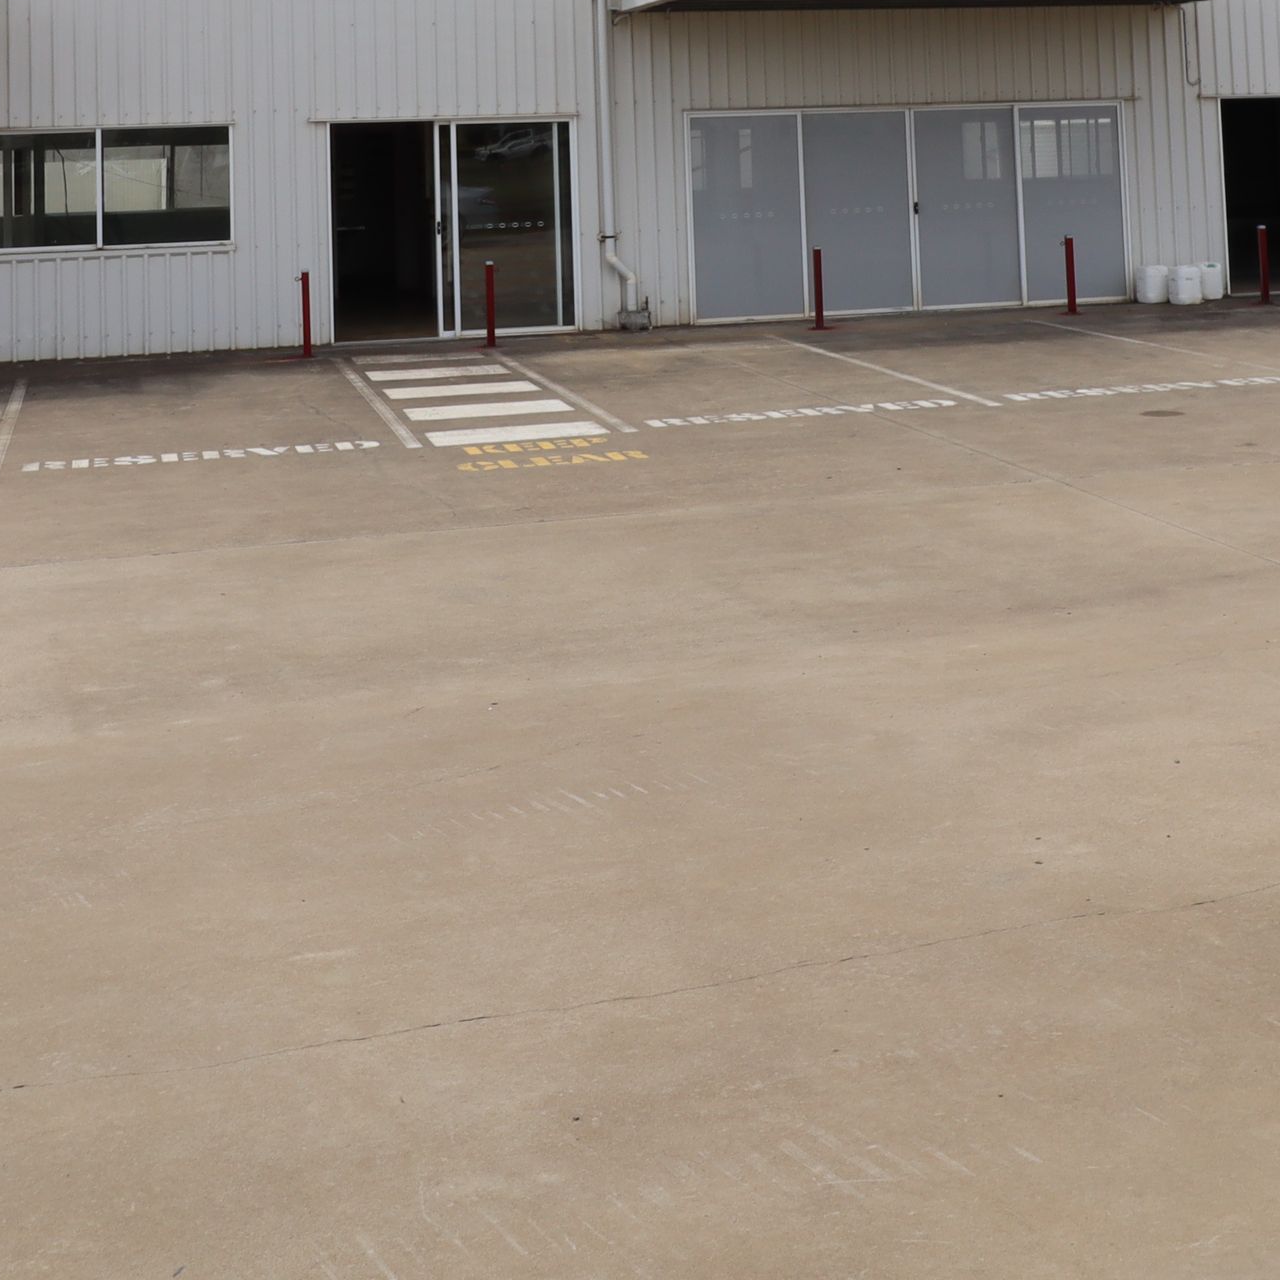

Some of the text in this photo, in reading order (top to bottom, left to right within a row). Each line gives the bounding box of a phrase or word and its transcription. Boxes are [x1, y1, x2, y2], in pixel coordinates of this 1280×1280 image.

[644, 399, 958, 427] RESERVED
[21, 440, 381, 472] RESERVED
[463, 437, 608, 455] KEEP
[456, 450, 648, 471] CLEAR
